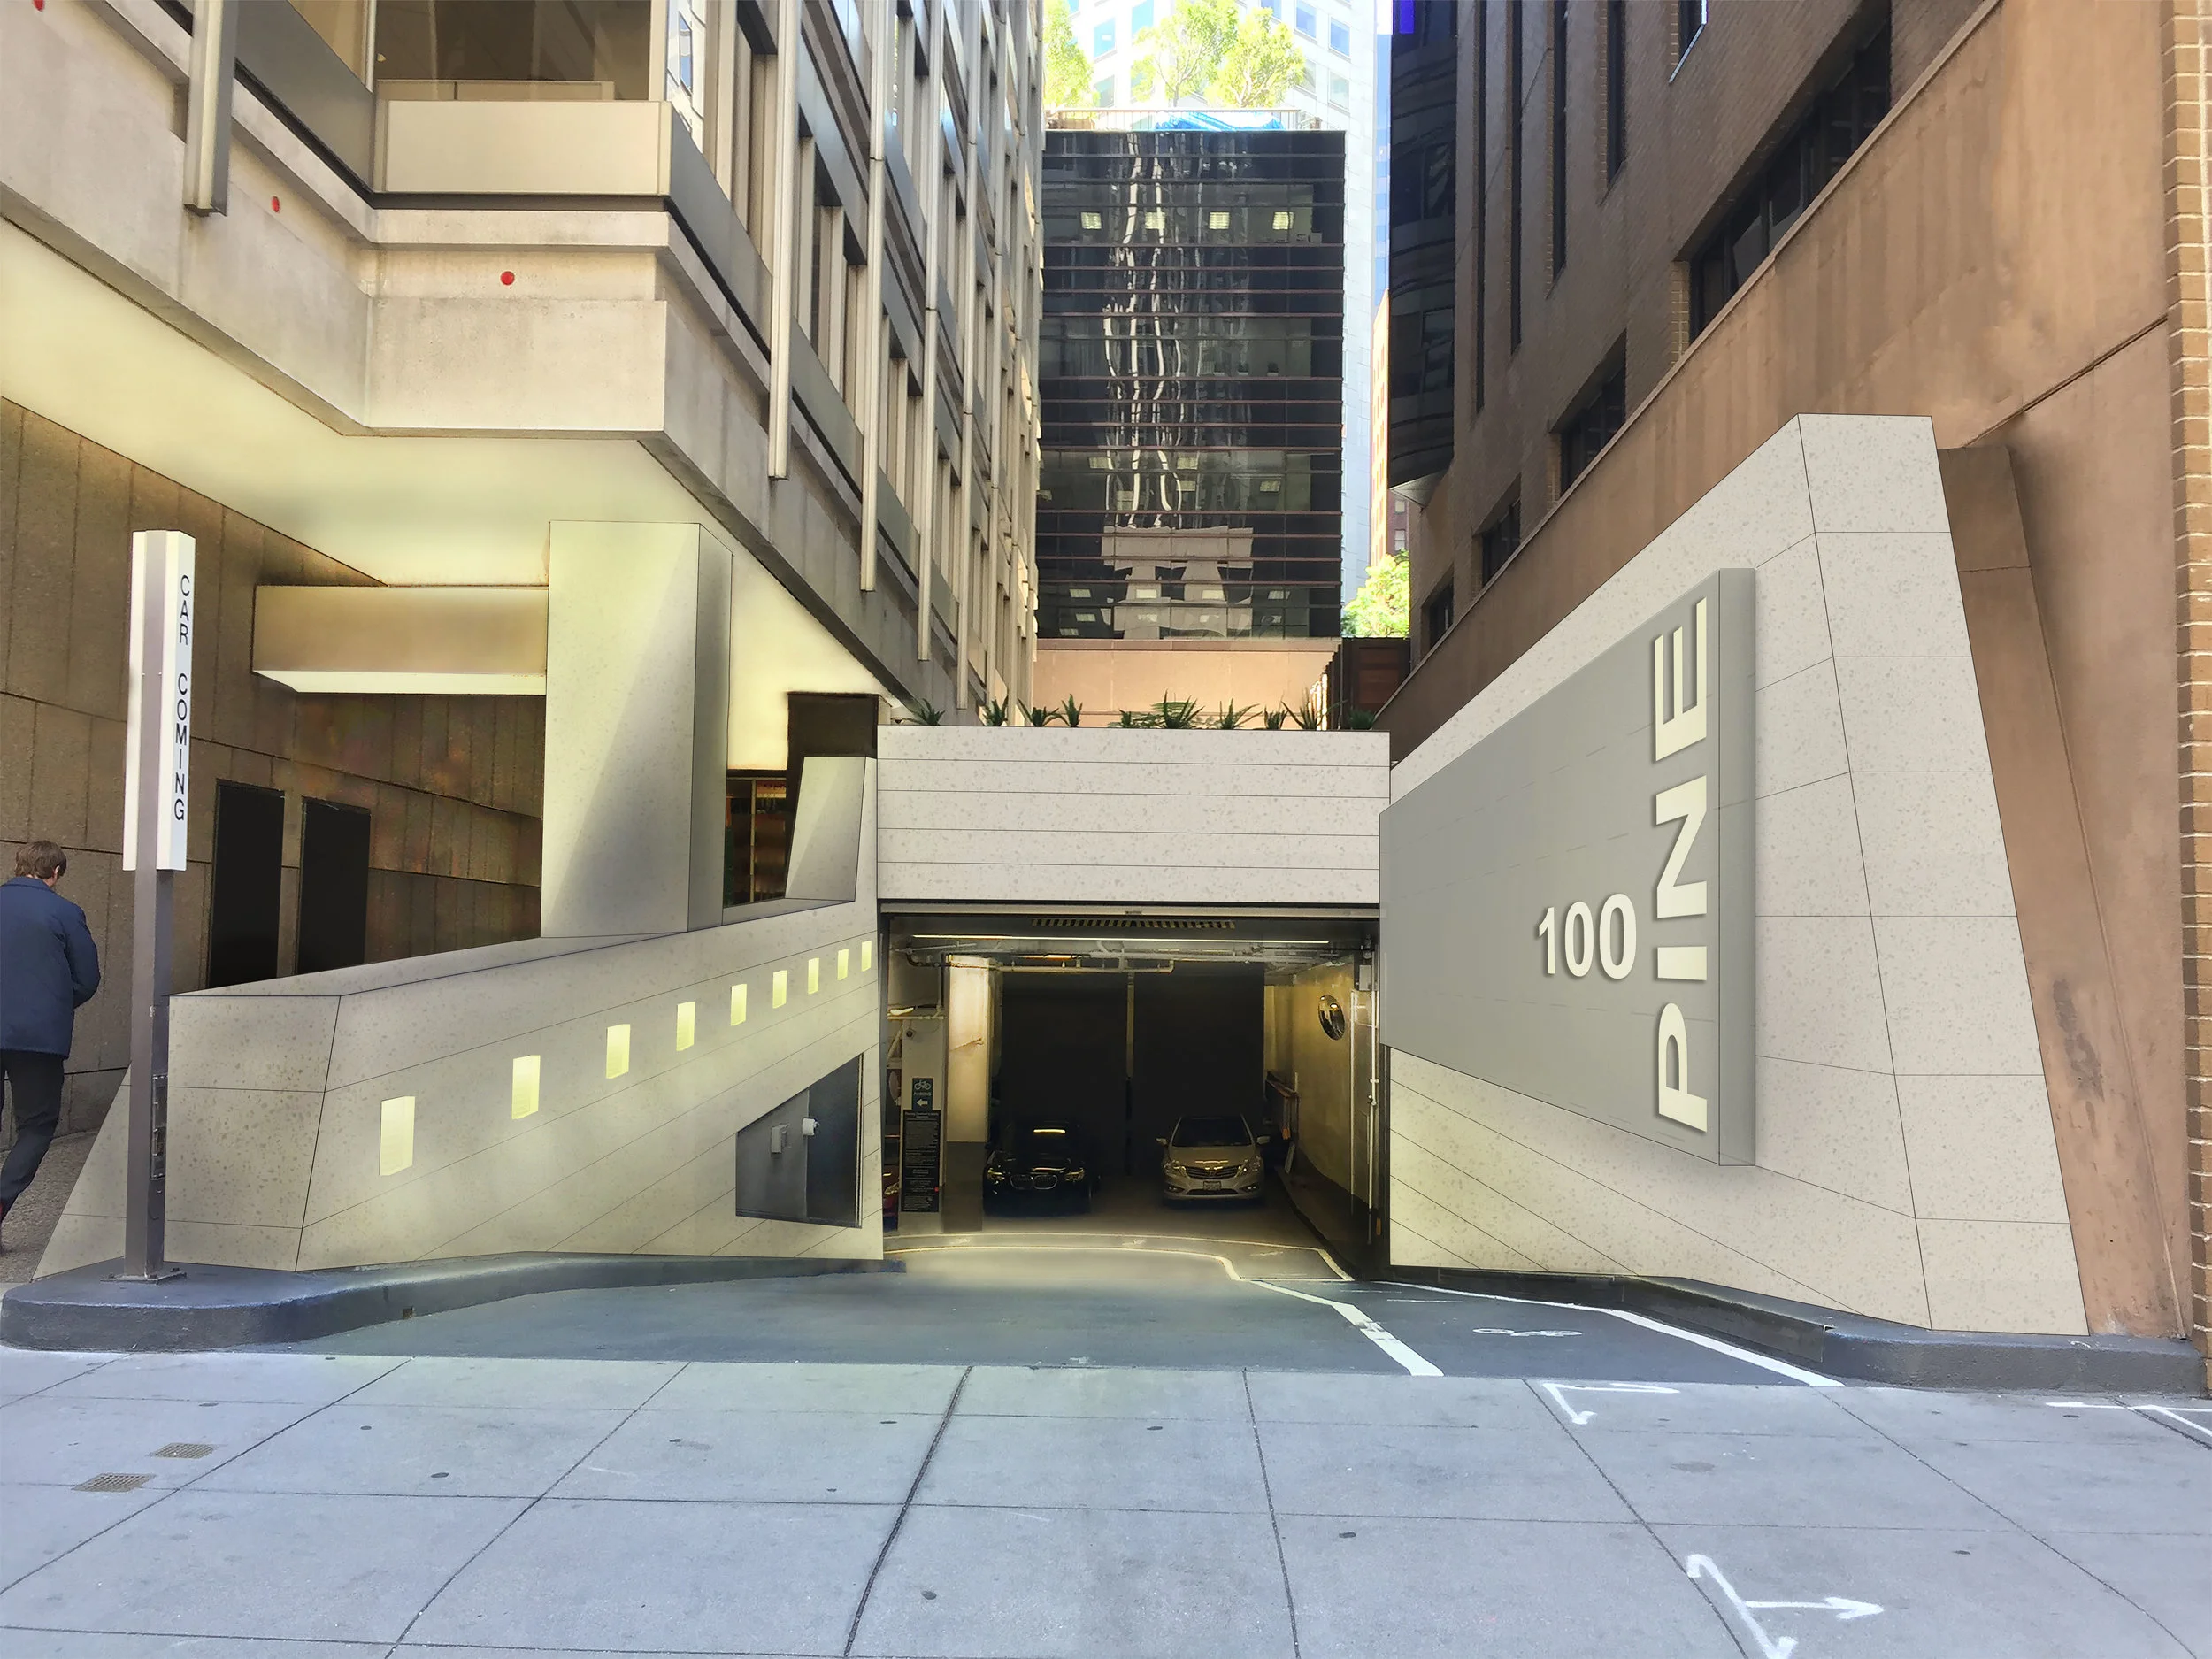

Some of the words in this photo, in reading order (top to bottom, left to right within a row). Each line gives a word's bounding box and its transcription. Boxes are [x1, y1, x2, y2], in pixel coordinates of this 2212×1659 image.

[180, 574, 190, 646] CAR
[173, 672, 188, 821] COMING
[1654, 595, 1708, 1133] PINE
[1538, 893, 1637, 979] 100
